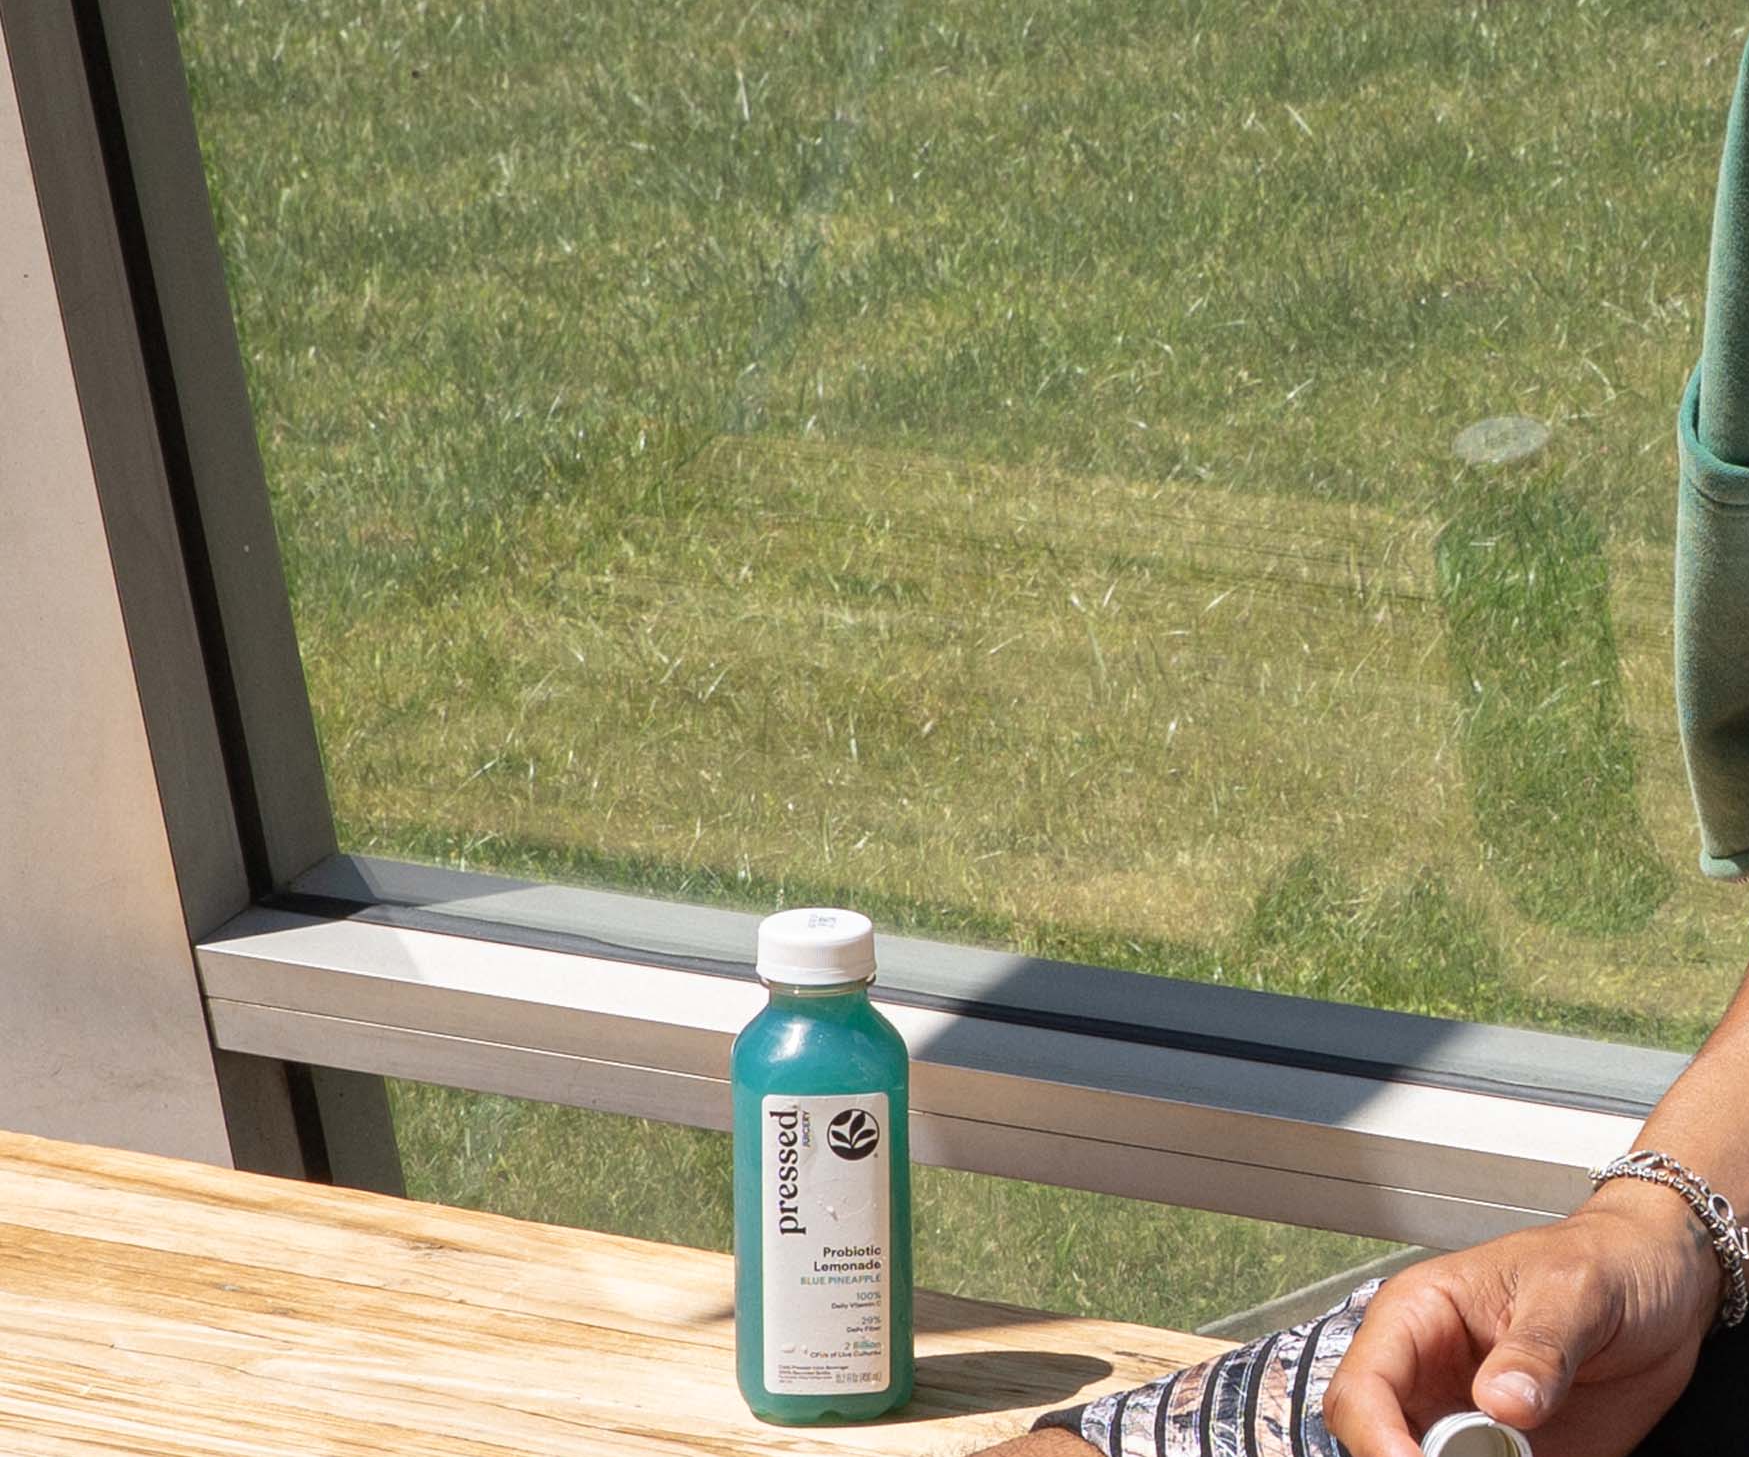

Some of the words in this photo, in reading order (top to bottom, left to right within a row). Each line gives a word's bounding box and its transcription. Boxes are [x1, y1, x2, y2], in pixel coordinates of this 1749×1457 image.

[801, 1111, 811, 1147] JUICERY
[769, 1110, 807, 1235] pressed
[823, 1245, 882, 1258] Probiotic
[814, 1260, 882, 1272] Lemonade
[800, 1276, 826, 1285] BLUE
[828, 1274, 881, 1285] PINEAPPLE
[856, 1292, 881, 1301] 100%
